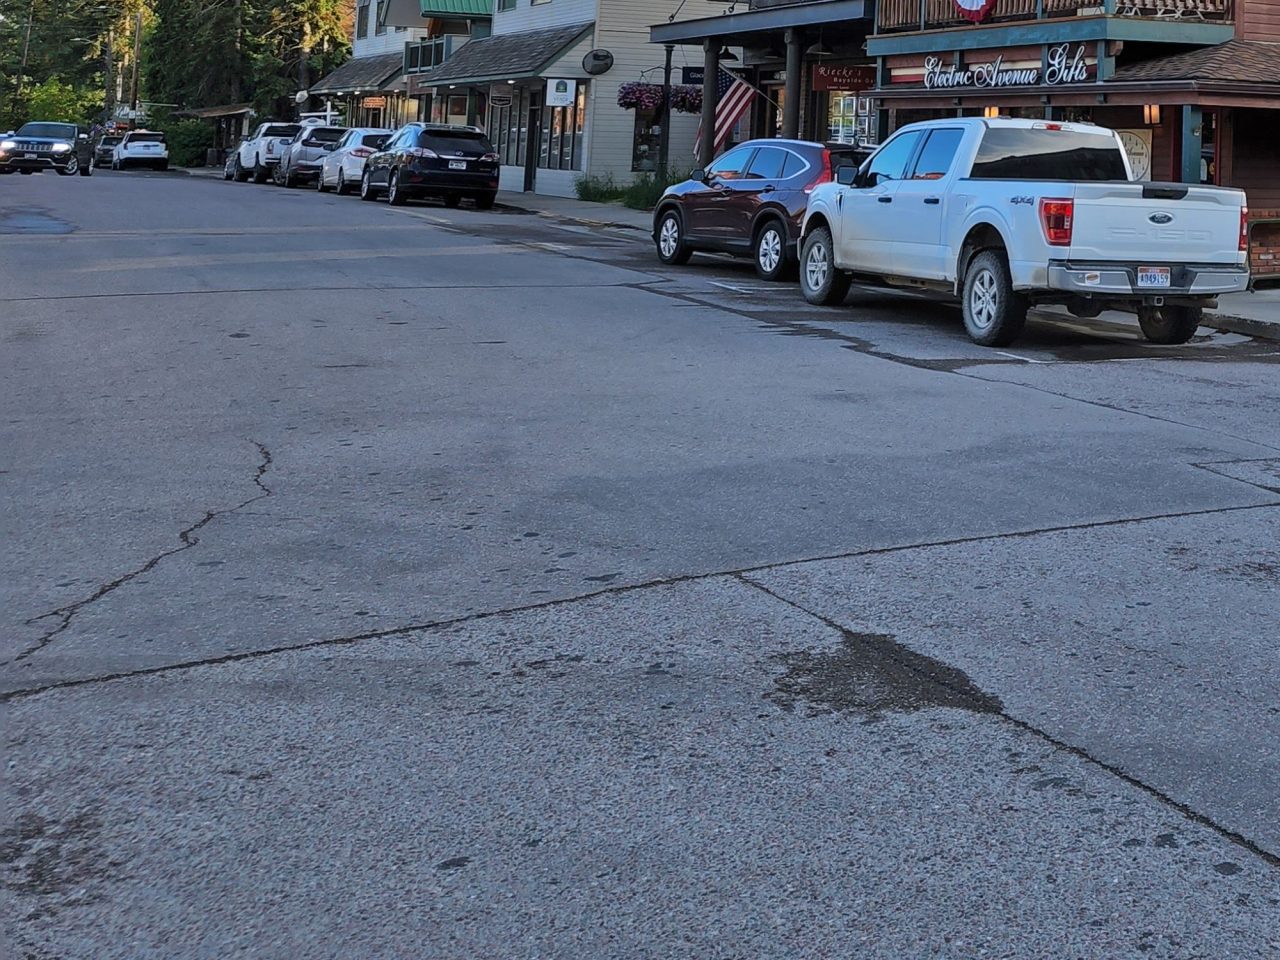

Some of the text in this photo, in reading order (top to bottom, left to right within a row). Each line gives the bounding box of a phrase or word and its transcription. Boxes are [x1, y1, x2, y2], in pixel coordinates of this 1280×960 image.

[924, 43, 1088, 90] Electric Avenue Gifts
